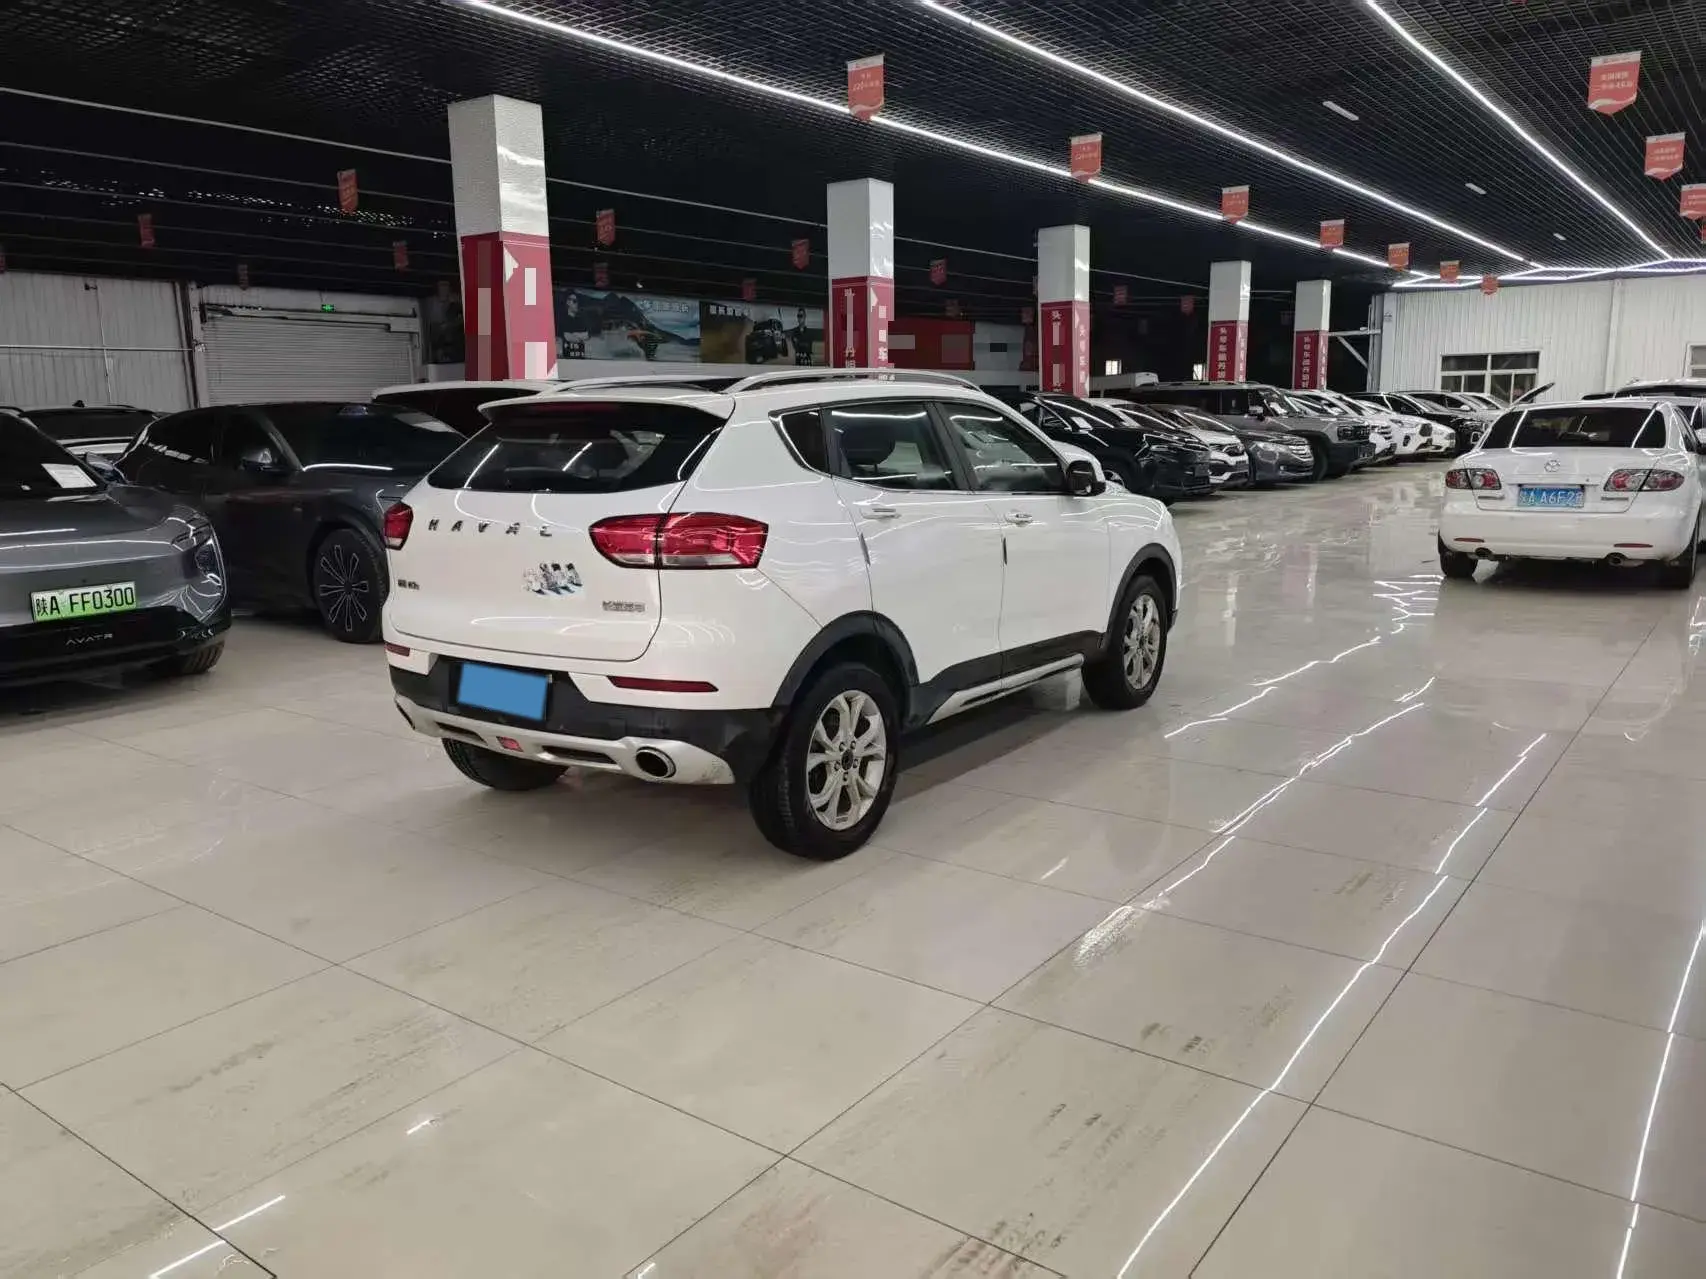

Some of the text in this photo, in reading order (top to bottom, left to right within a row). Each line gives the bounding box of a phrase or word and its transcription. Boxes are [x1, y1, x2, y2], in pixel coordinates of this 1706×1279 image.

[428, 518, 552, 537] HAVAL
[35, 587, 135, 617] 陕A FF0300
